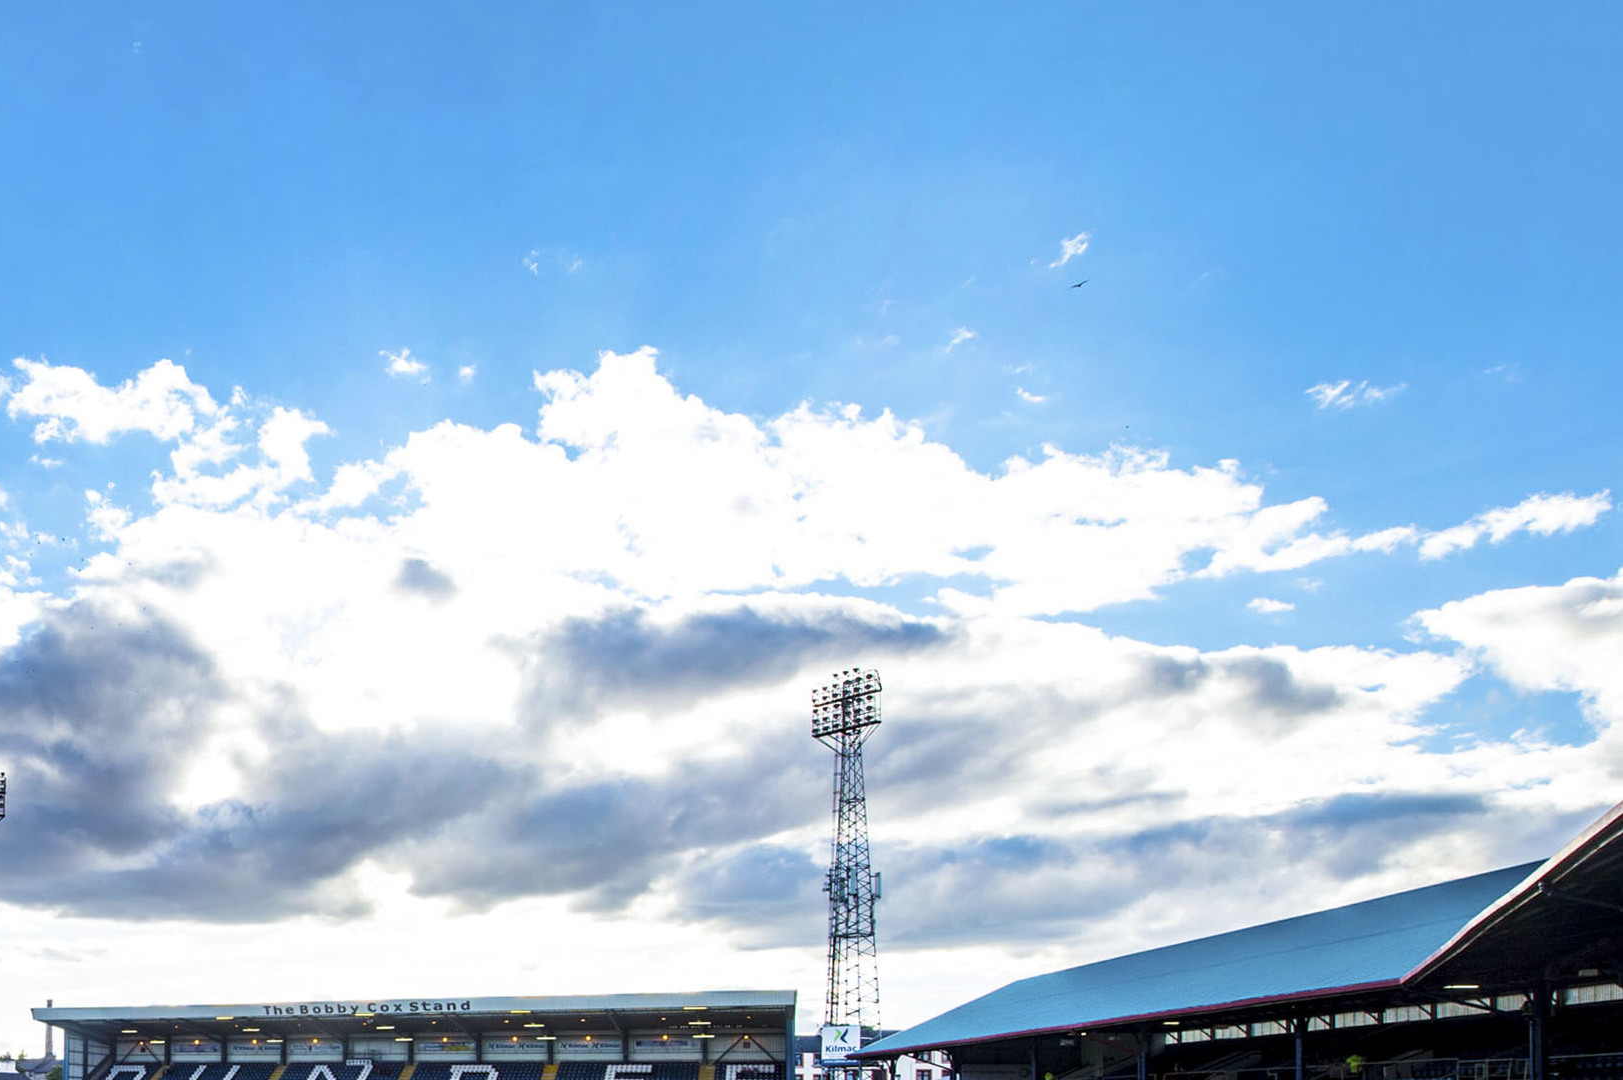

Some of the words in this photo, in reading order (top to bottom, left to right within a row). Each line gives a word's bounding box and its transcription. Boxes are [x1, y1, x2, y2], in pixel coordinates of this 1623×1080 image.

[263, 1005, 294, 1015] The
[300, 1003, 358, 1015] Bobby
[367, 1002, 403, 1013] Cox
[409, 1000, 471, 1011] Stand
[825, 1045, 857, 1053] Kilmac
